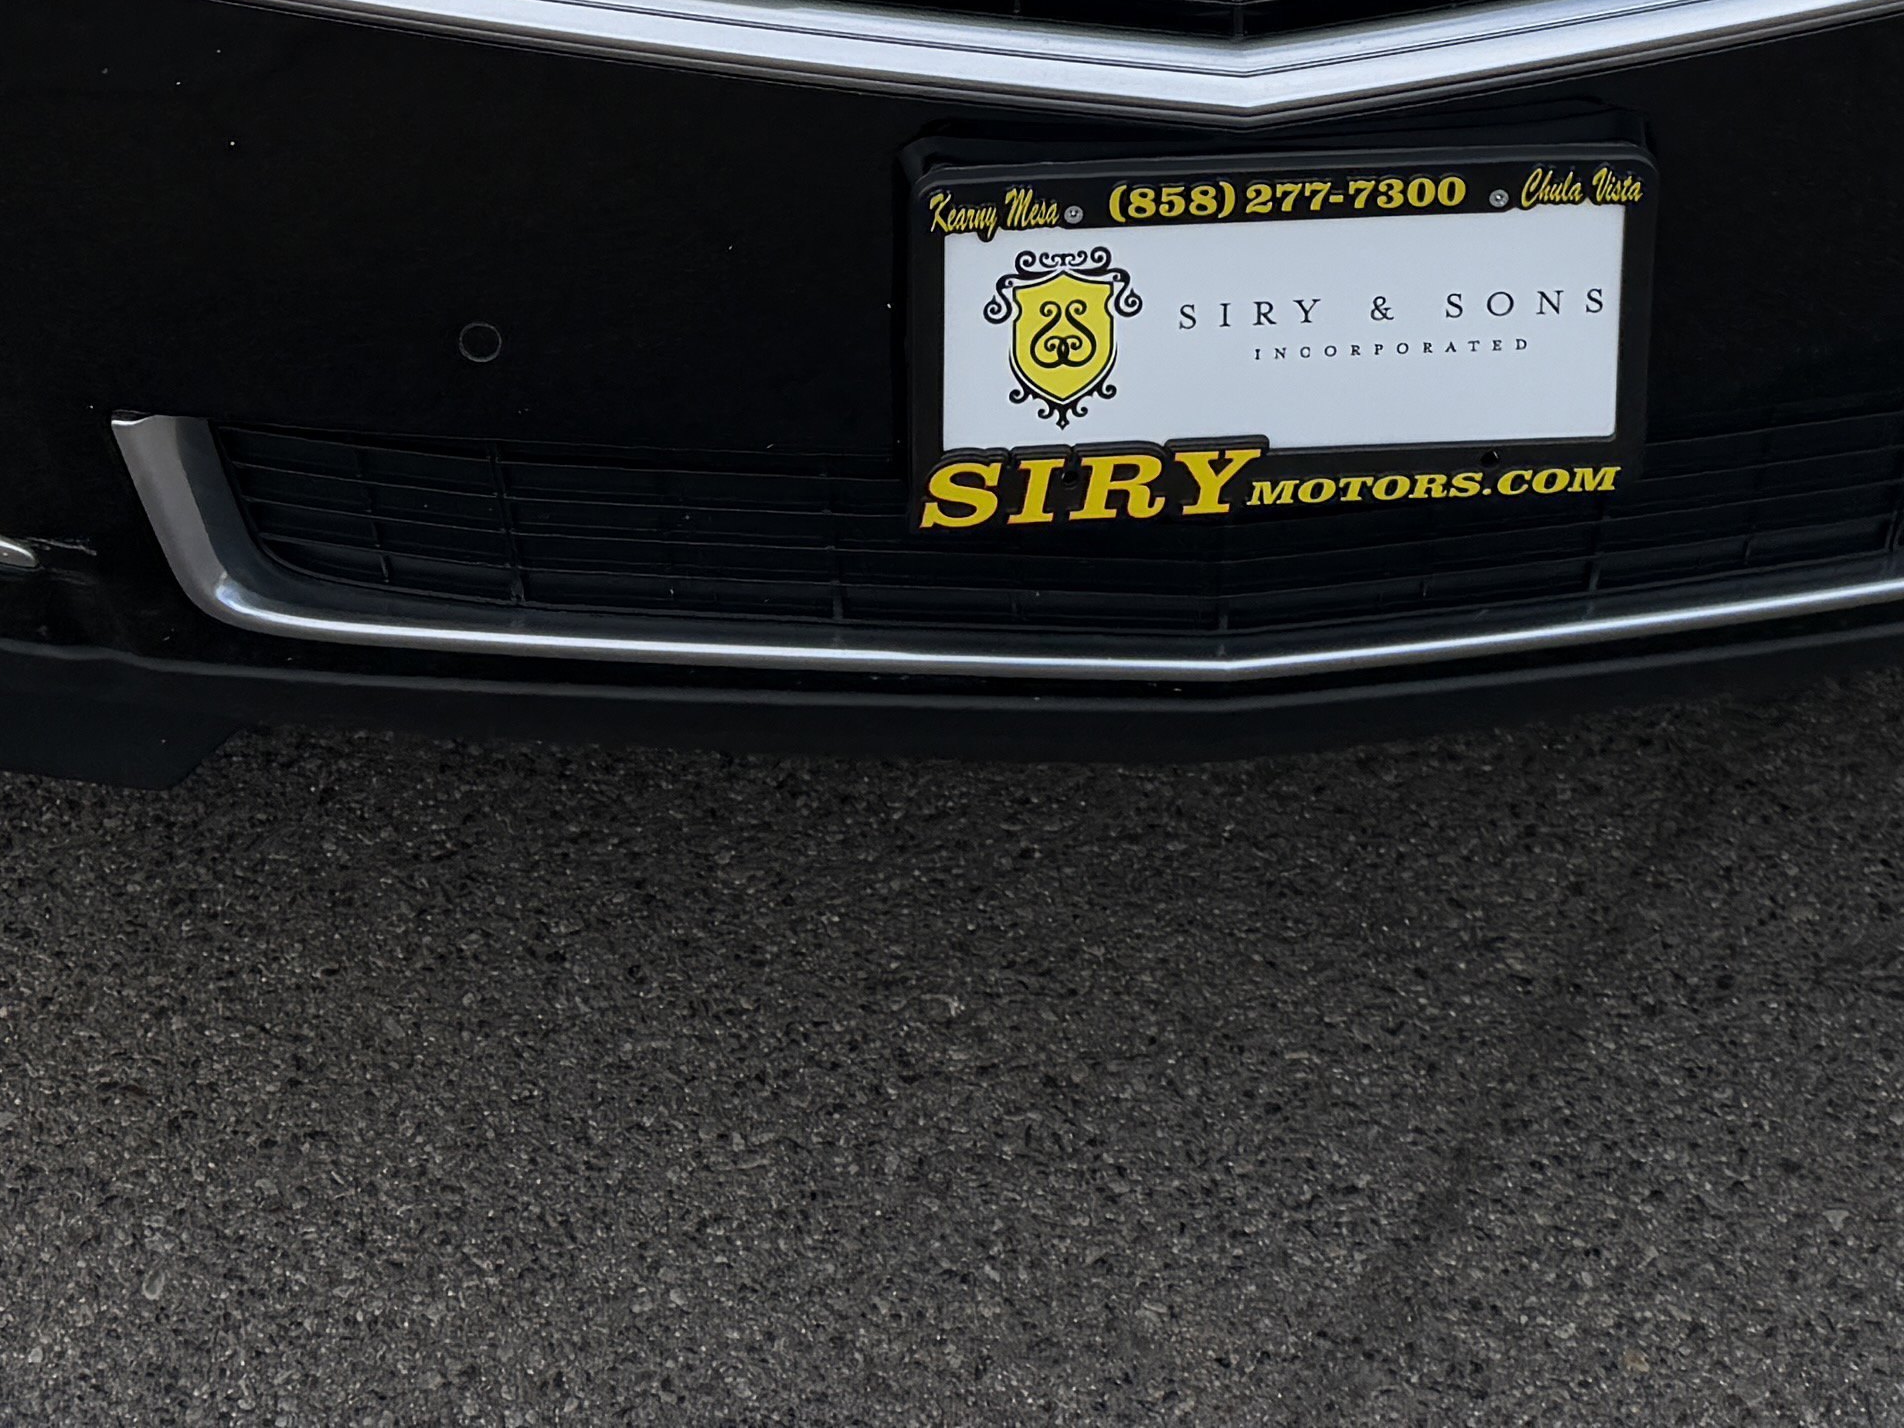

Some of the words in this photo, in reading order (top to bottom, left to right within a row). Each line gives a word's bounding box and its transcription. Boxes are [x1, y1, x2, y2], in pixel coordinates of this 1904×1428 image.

[1245, 176, 1466, 213] 277-7300
[1521, 167, 1585, 207] Chula
[1592, 167, 1643, 203] Vista
[929, 191, 998, 239] Kearny
[1004, 188, 1060, 228] Mesa
[1179, 298, 1321, 330] SIRY
[1370, 296, 1395, 321] &
[1445, 288, 1604, 319] SONS
[1254, 338, 1529, 360] INCORPORATED
